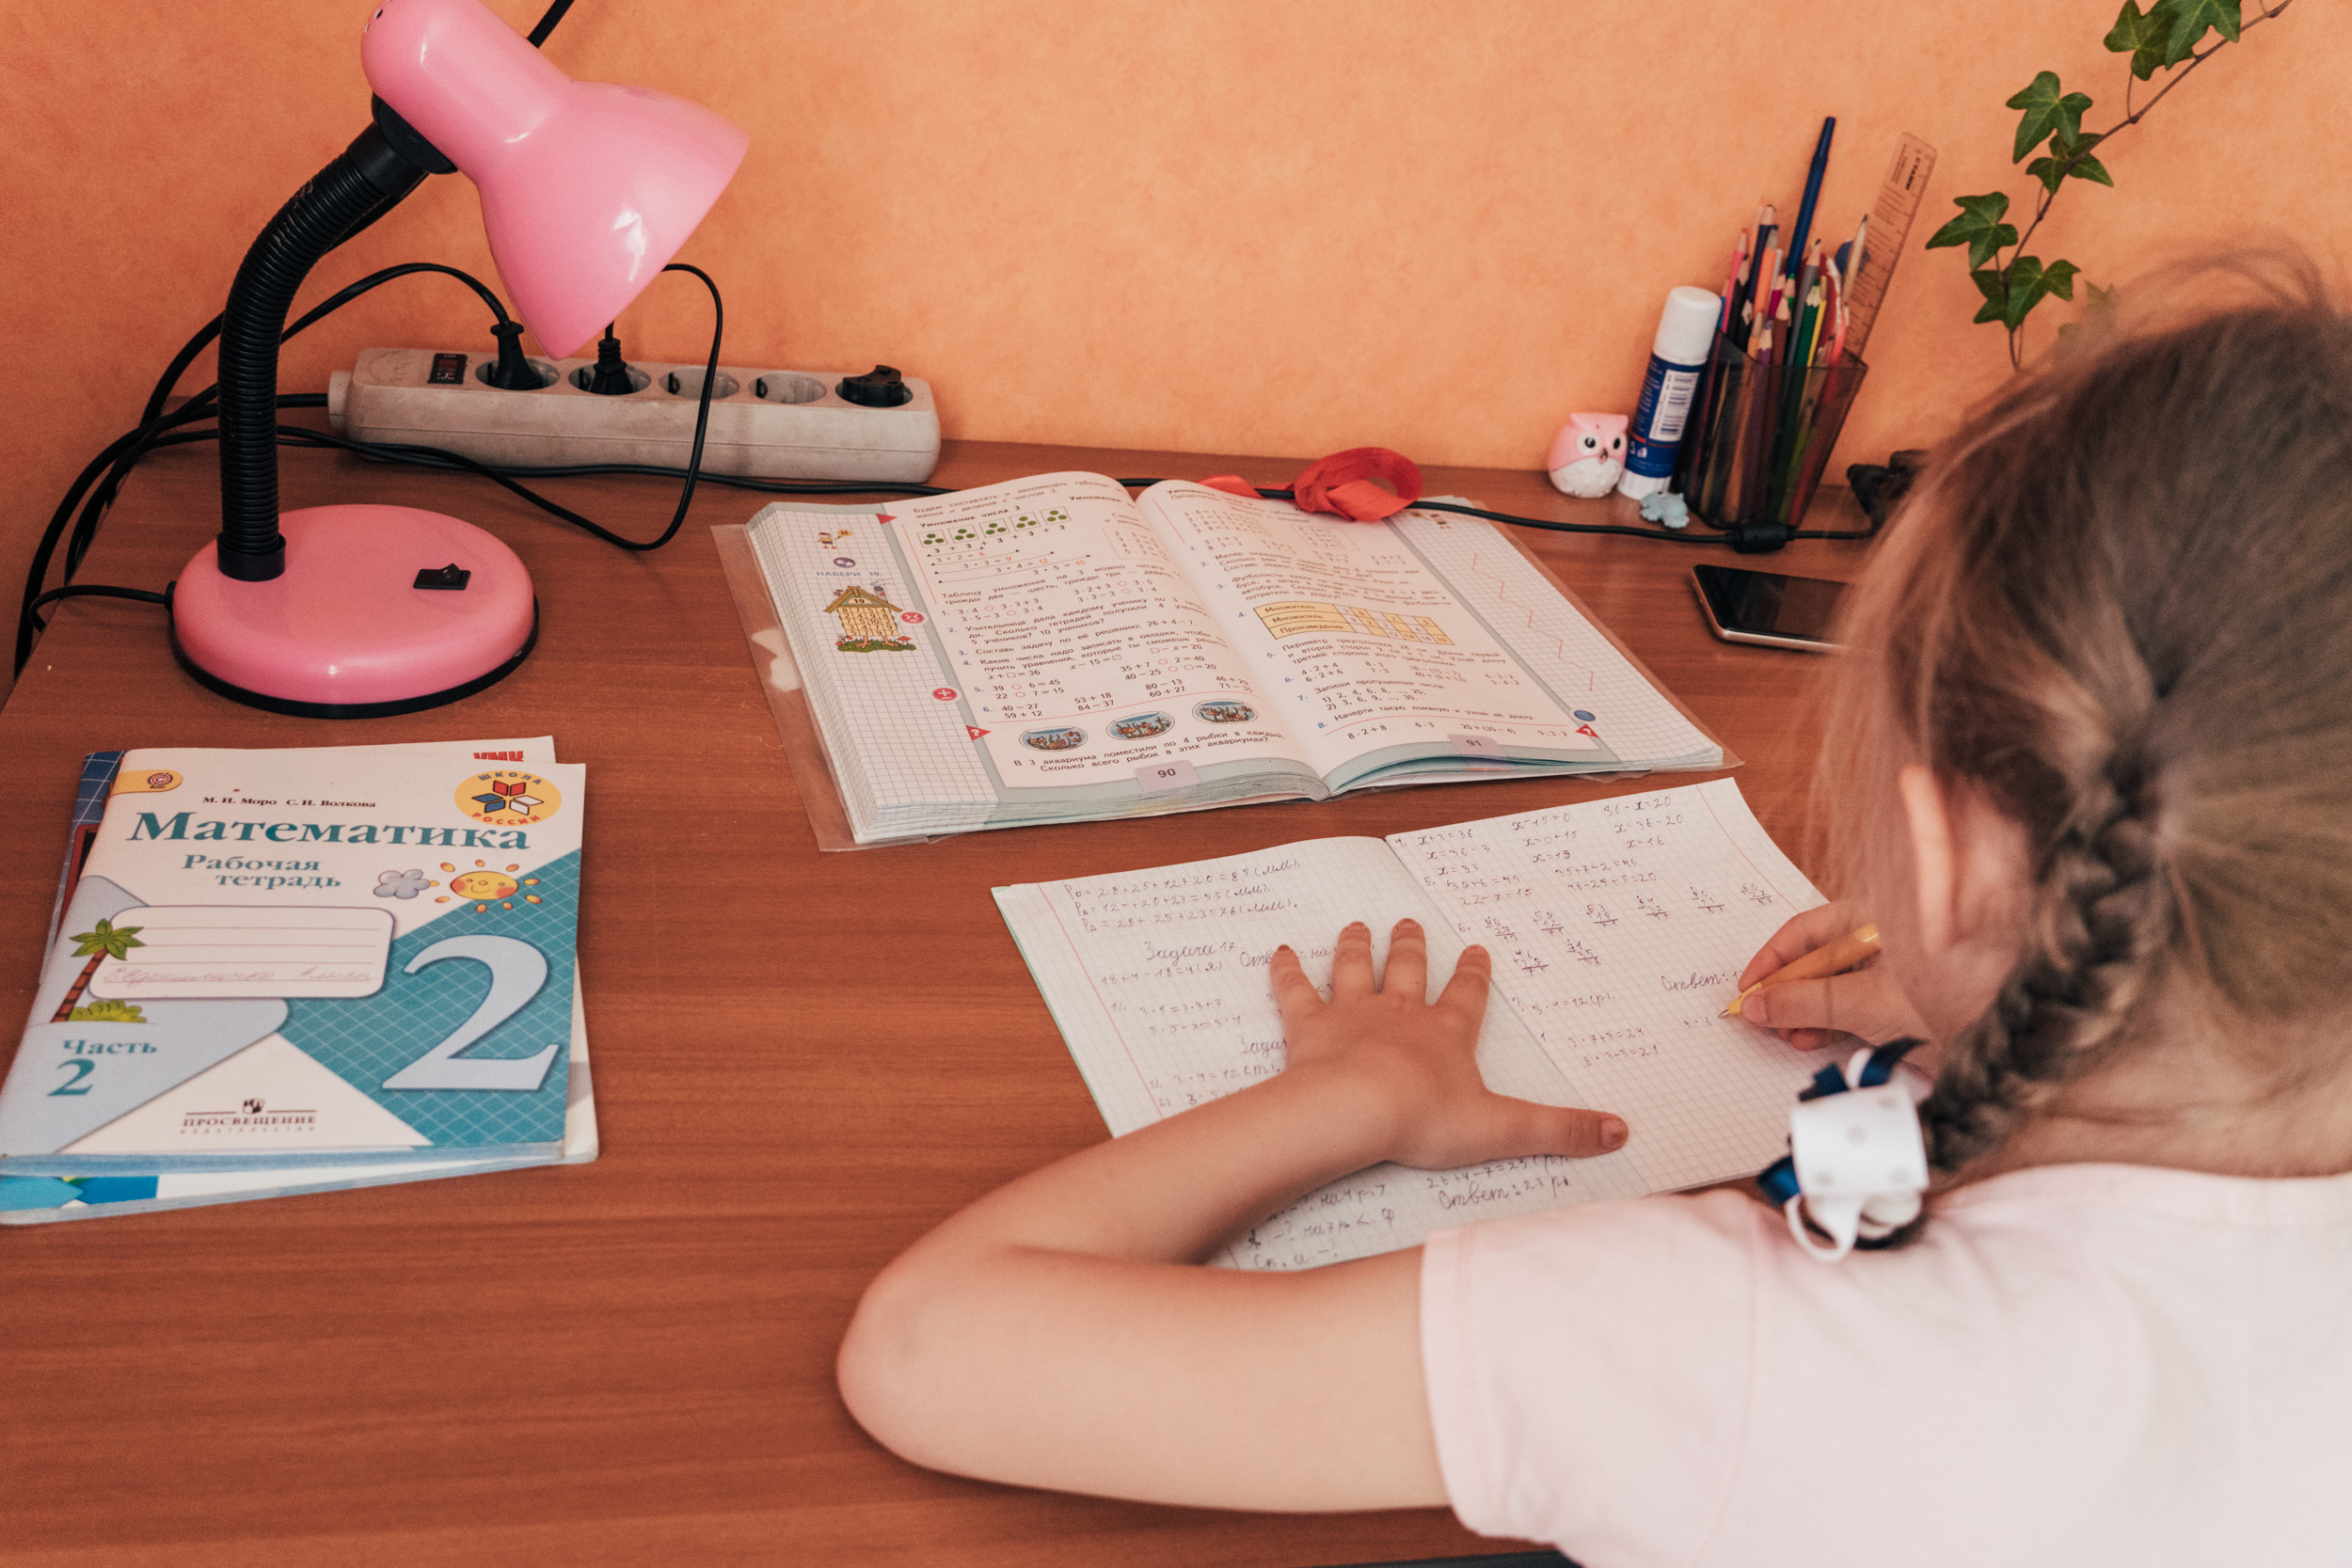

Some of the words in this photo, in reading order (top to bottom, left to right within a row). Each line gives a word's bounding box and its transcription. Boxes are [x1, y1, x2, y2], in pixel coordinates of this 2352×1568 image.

[949, 495, 998, 507] составлять
[961, 501, 997, 512] деления
[919, 515, 976, 528] Умножение
[981, 509, 1009, 517] числа
[942, 590, 981, 598] Таблицу
[993, 578, 1045, 593] умножения
[944, 596, 981, 605] трижды
[1027, 584, 1057, 594] шесть,
[1063, 574, 1100, 585] трижды
[1246, 591, 1290, 600] потратили
[965, 620, 1025, 632] Учительница
[1033, 614, 1056, 624] дала
[1063, 605, 1104, 617] каждому
[1111, 598, 1147, 608] ученику
[1264, 604, 1315, 613] Множитель
[995, 626, 1037, 636] Сколько
[1048, 614, 1092, 627] тетрадей
[1103, 605, 1147, 616] получили
[1272, 614, 1324, 624] Множитель
[984, 632, 1032, 644] учеников?
[1057, 618, 1104, 633] учеников?
[1279, 624, 1344, 634] Произведение
[976, 646, 1014, 655] Составь
[1021, 641, 1053, 650] задачу
[1095, 624, 1141, 637] решению:
[1051, 648, 1073, 657] надо
[1080, 639, 1121, 651] записать
[1140, 630, 1179, 639] окошки,
[1281, 639, 1328, 652] Периметр
[1302, 644, 1333, 654] второй
[1022, 656, 1075, 669] уравнения,
[1081, 645, 1121, 658] которые
[1293, 652, 1329, 665] третьей
[1314, 681, 1350, 694] Запиши
[1334, 708, 1373, 721] Начерти
[1043, 753, 1097, 766] аквариума
[1104, 745, 1157, 758] поместили
[1197, 733, 1228, 743] рыбки
[1466, 739, 1482, 748] 91
[1040, 763, 1085, 771] Сколько
[1091, 759, 1120, 768] всего
[1127, 752, 1159, 764] рыбок
[1179, 745, 1200, 753] этих
[1207, 736, 1268, 750] аквариумах?
[478, 772, 542, 784] ШКОЛА
[1157, 768, 1176, 779] 90
[203, 796, 218, 804] М.
[321, 800, 376, 808] Волкова
[471, 813, 540, 825] РОССИИ
[125, 811, 531, 850] Математика
[182, 854, 322, 871] Рабочая
[215, 871, 341, 890] тетрадь
[382, 934, 562, 1092] 2
[63, 1039, 157, 1054] Часть
[47, 1058, 96, 1097] 2
[182, 1116, 317, 1127] ПРОСВЕЩЕНИЕ
